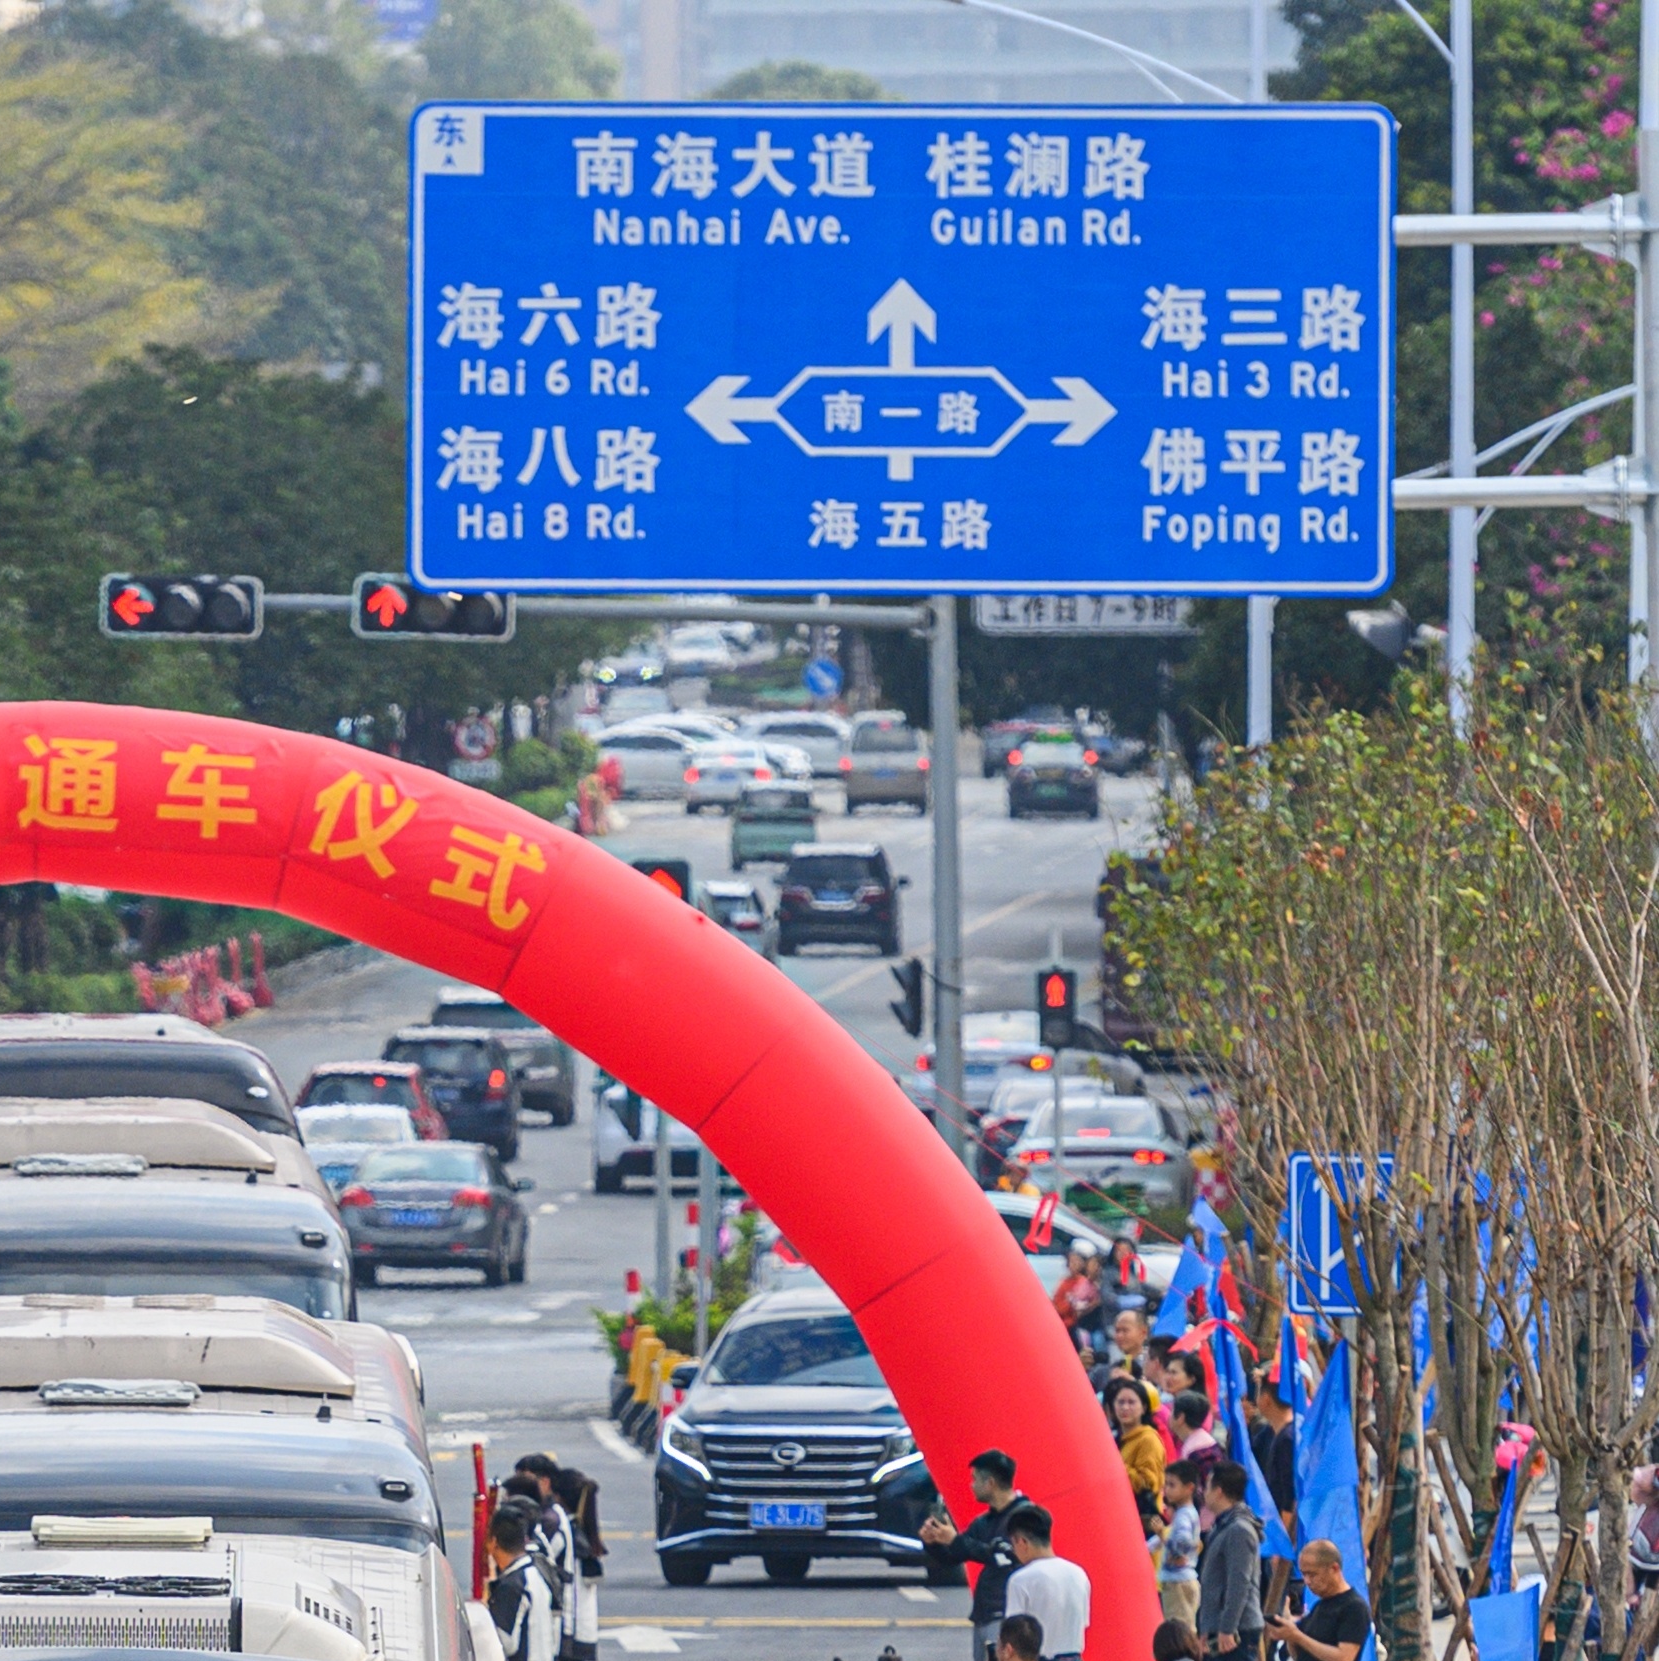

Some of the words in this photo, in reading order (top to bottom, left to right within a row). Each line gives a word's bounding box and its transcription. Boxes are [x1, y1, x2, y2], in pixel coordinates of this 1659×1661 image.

[434, 113, 467, 147] 东
[572, 131, 876, 200] 南海大道
[926, 132, 1150, 200] 桂澜路
[593, 208, 741, 246] Nanhai
[764, 208, 852, 246] Ave.
[931, 208, 1067, 247] Guilan
[1082, 208, 1142, 247] Rd.
[436, 281, 663, 351] 海六路
[1140, 283, 1367, 352] 海三路
[459, 358, 527, 397] Hai
[544, 358, 572, 397] 6
[590, 358, 651, 397] Rd.
[1161, 359, 1229, 398] Hai
[1244, 360, 1271, 399] 3
[1290, 361, 1351, 399] Rd.
[821, 389, 981, 435] 南一路
[436, 424, 662, 494] 海八路
[1140, 427, 1366, 497] 佛平路
[456, 502, 524, 541] Hai
[543, 502, 570, 541] 8
[586, 502, 647, 541] Rd.
[807, 498, 993, 551] 海五路
[1142, 504, 1281, 554] Foping
[1299, 505, 1360, 544] Rd.
